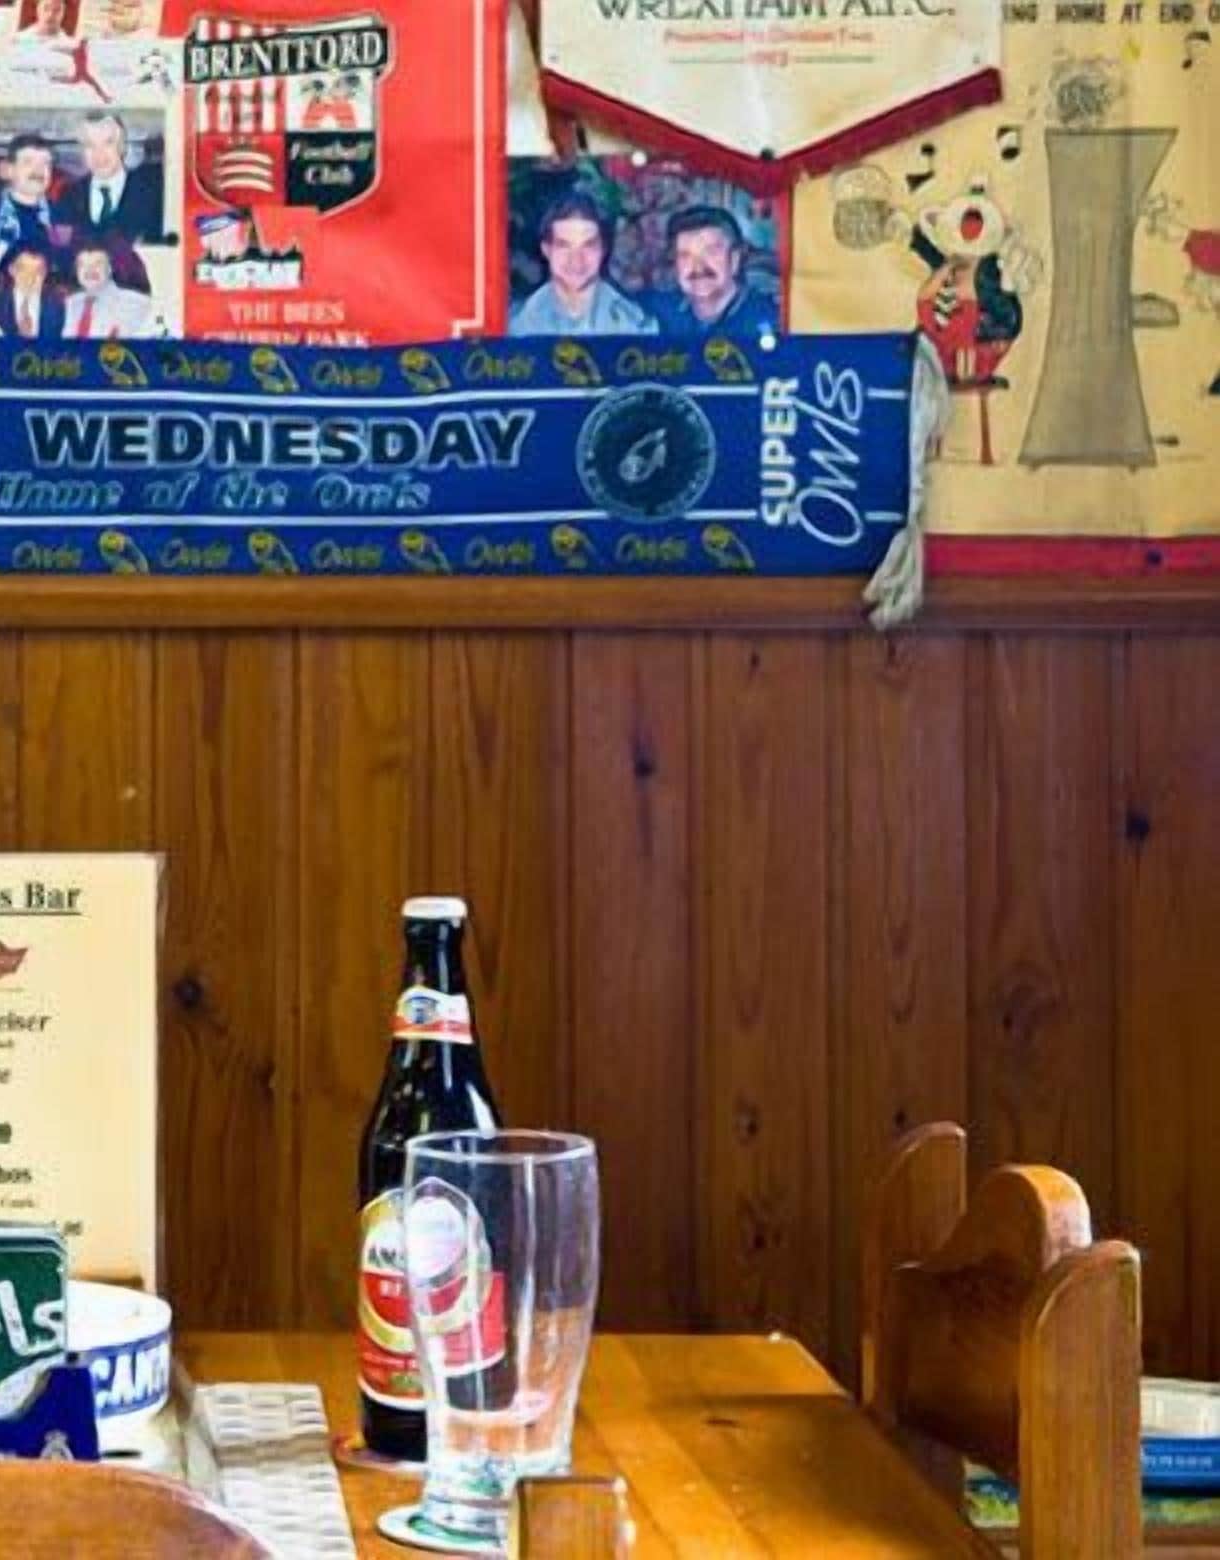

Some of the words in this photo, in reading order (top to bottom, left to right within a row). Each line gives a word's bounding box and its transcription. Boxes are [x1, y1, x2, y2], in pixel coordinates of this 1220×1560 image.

[1055, 3, 1106, 24] HOME
[1121, 3, 1141, 24] AT
[1160, 3, 1195, 24] END
[188, 31, 382, 79] BRENTFORD
[229, 302, 277, 325] THE
[25, 408, 535, 470] WEDNESDAY
[760, 376, 798, 527] SUPER
[790, 360, 865, 546] Owls
[143, 471, 200, 509] of
[313, 472, 431, 510] Owls
[25, 881, 83, 909] Bar
